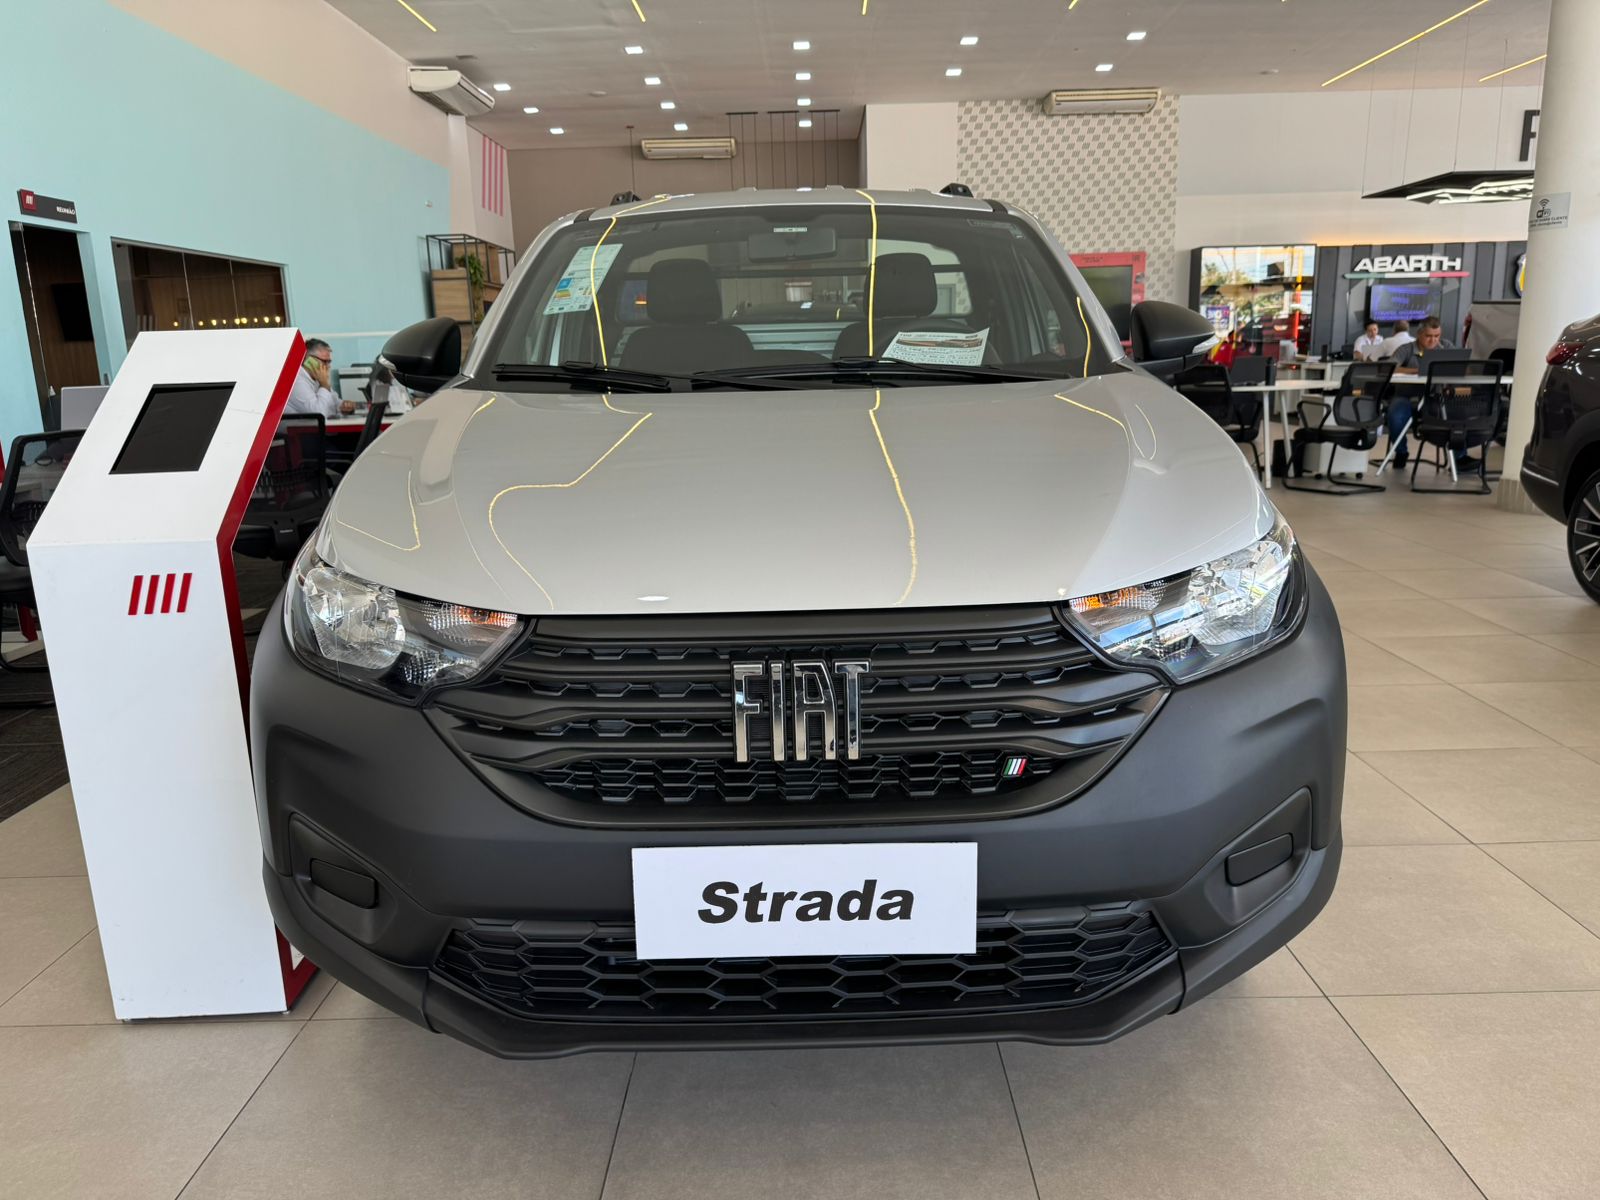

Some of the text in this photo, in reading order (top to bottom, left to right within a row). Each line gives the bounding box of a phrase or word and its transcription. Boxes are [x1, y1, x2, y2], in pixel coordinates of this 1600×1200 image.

[1354, 255, 1462, 273] ABARTH
[732, 658, 871, 763] FIAT
[697, 879, 915, 924] Strada
